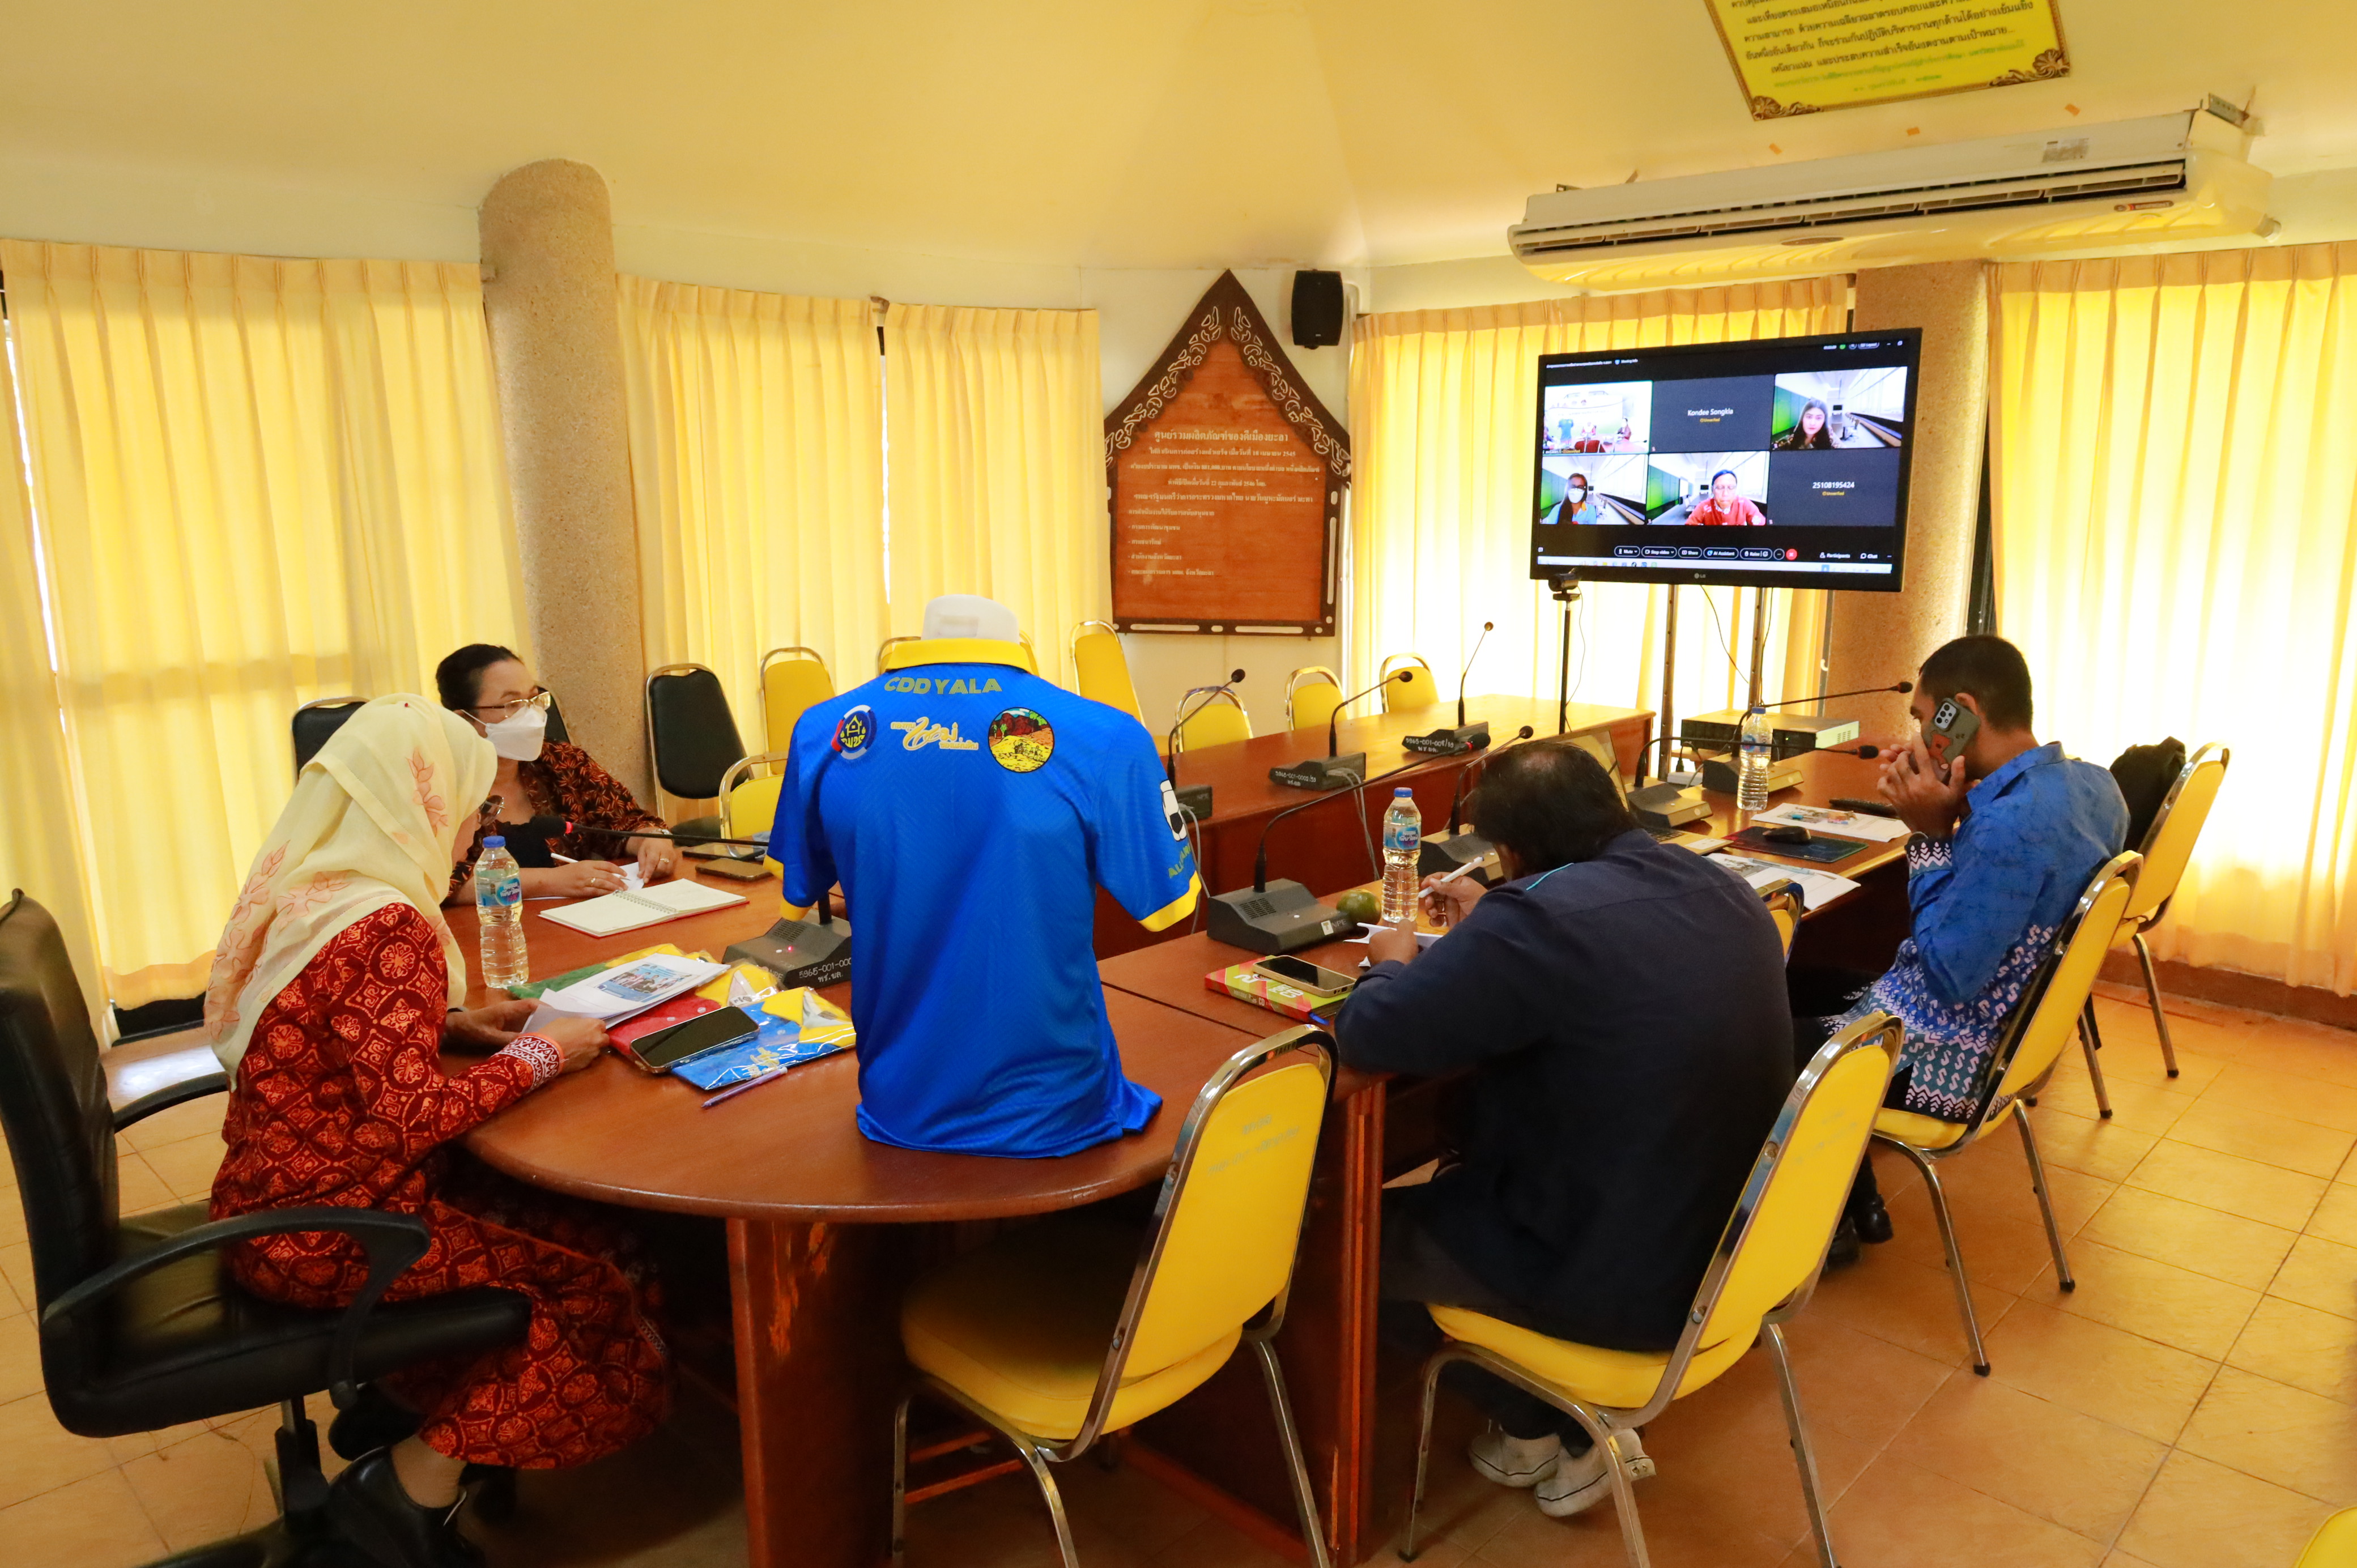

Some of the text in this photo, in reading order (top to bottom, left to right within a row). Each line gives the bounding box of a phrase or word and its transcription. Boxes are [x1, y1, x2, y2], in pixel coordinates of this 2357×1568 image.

[1710, 408, 1734, 416] Songkla
[1154, 429, 1288, 442] ศูนย์รวมผลิตภัณฑ์ของดีเมืองยะลา
[884, 676, 1003, 695] CDD YALA
